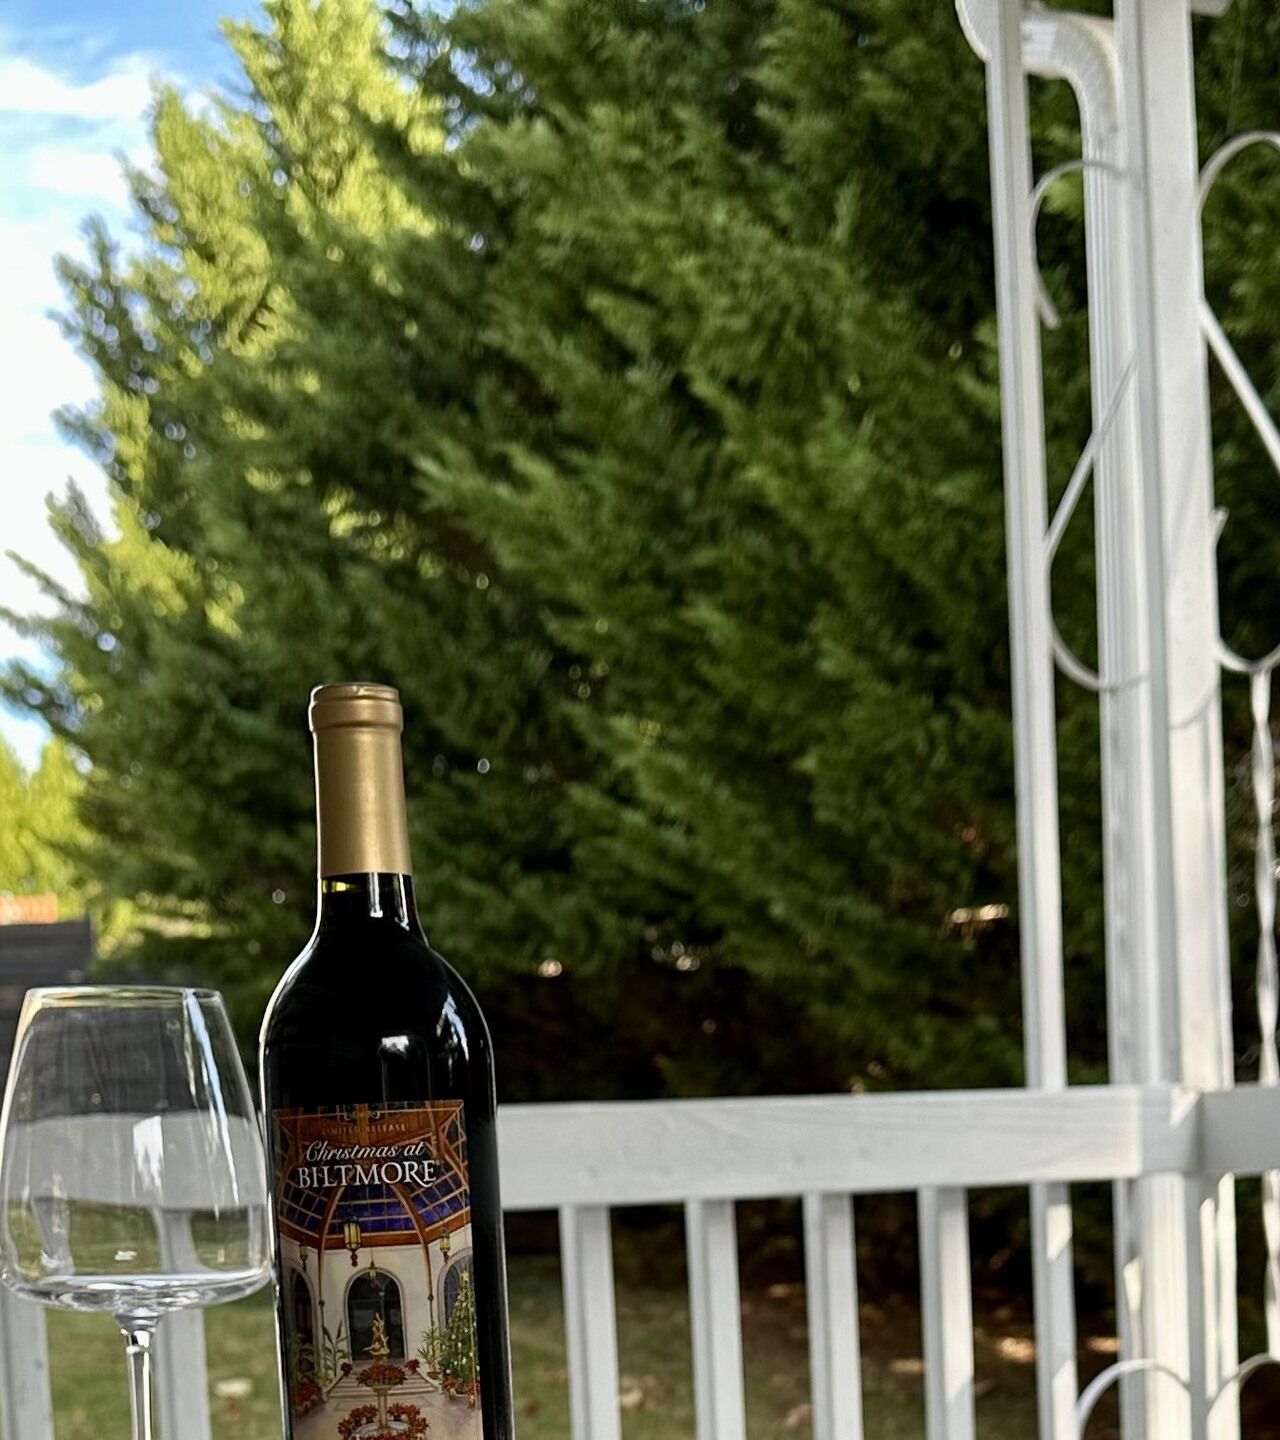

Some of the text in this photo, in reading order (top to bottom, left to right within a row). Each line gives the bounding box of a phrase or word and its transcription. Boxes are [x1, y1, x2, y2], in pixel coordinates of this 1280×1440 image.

[306, 1140, 426, 1162] Christmas at
[297, 1160, 438, 1188] BILTMORE
